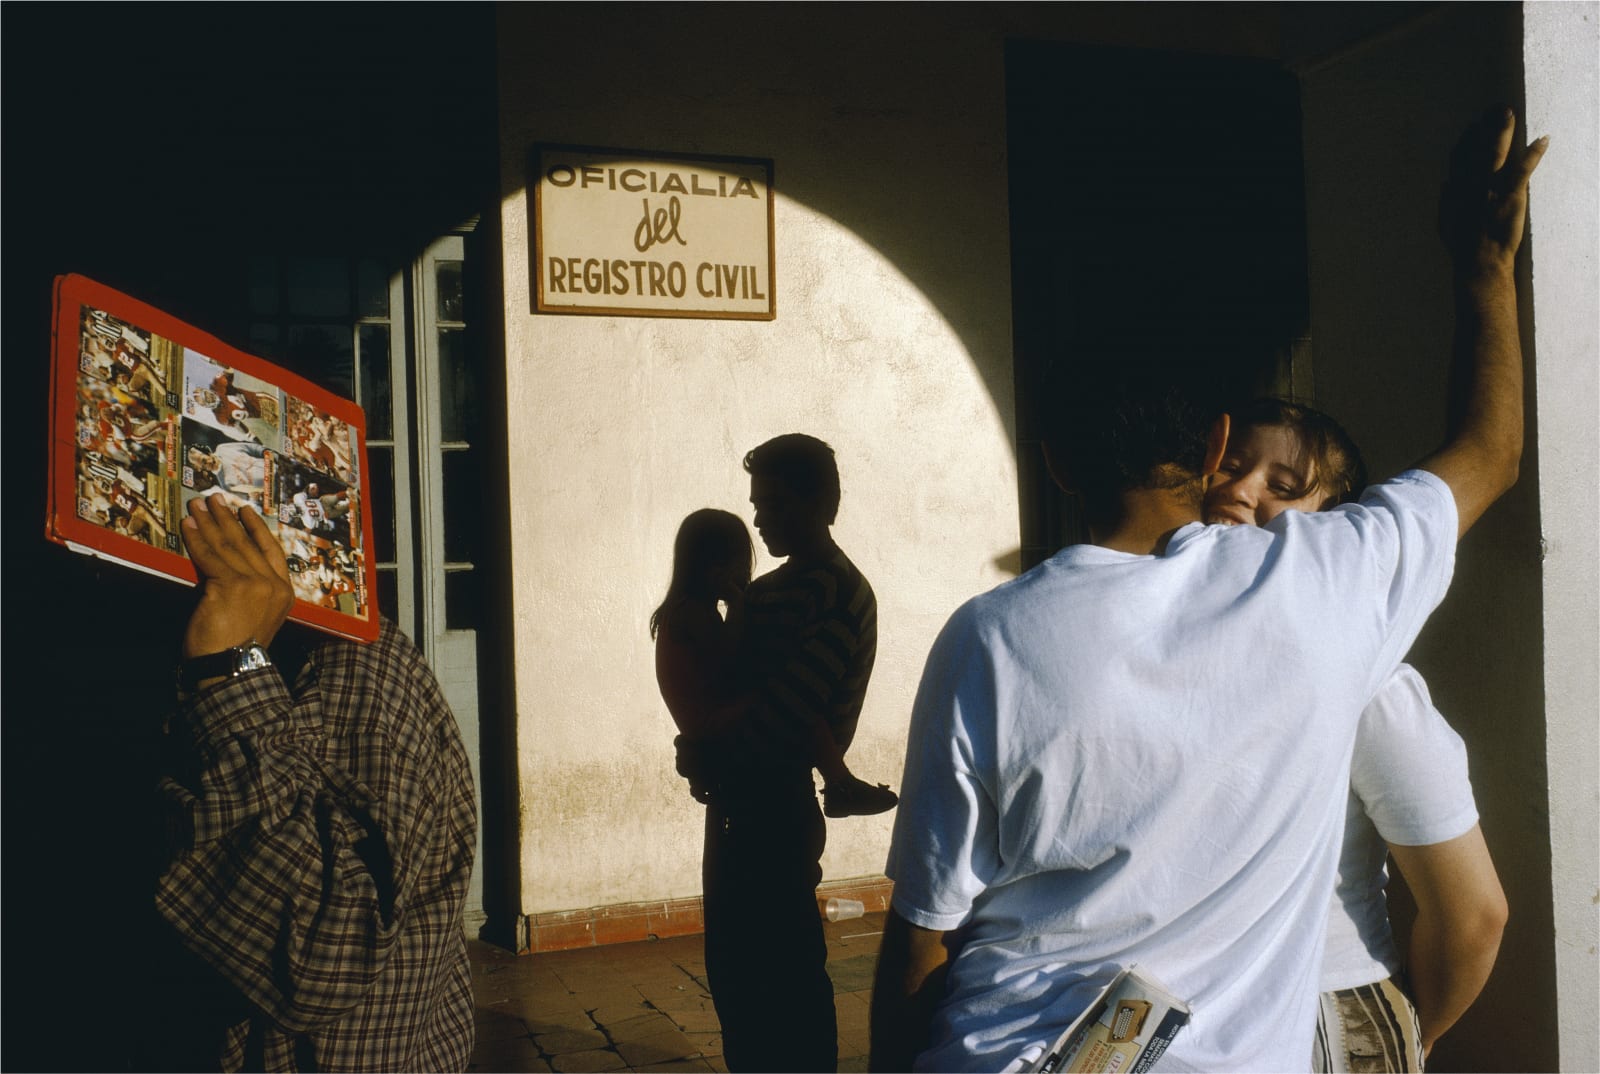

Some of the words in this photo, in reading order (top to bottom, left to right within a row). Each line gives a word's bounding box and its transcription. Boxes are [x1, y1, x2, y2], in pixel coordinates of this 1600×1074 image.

[547, 165, 760, 199] OFICIALIA
[634, 196, 687, 252] del
[549, 257, 686, 298] REGISTRO
[696, 262, 765, 300] CIVIL
